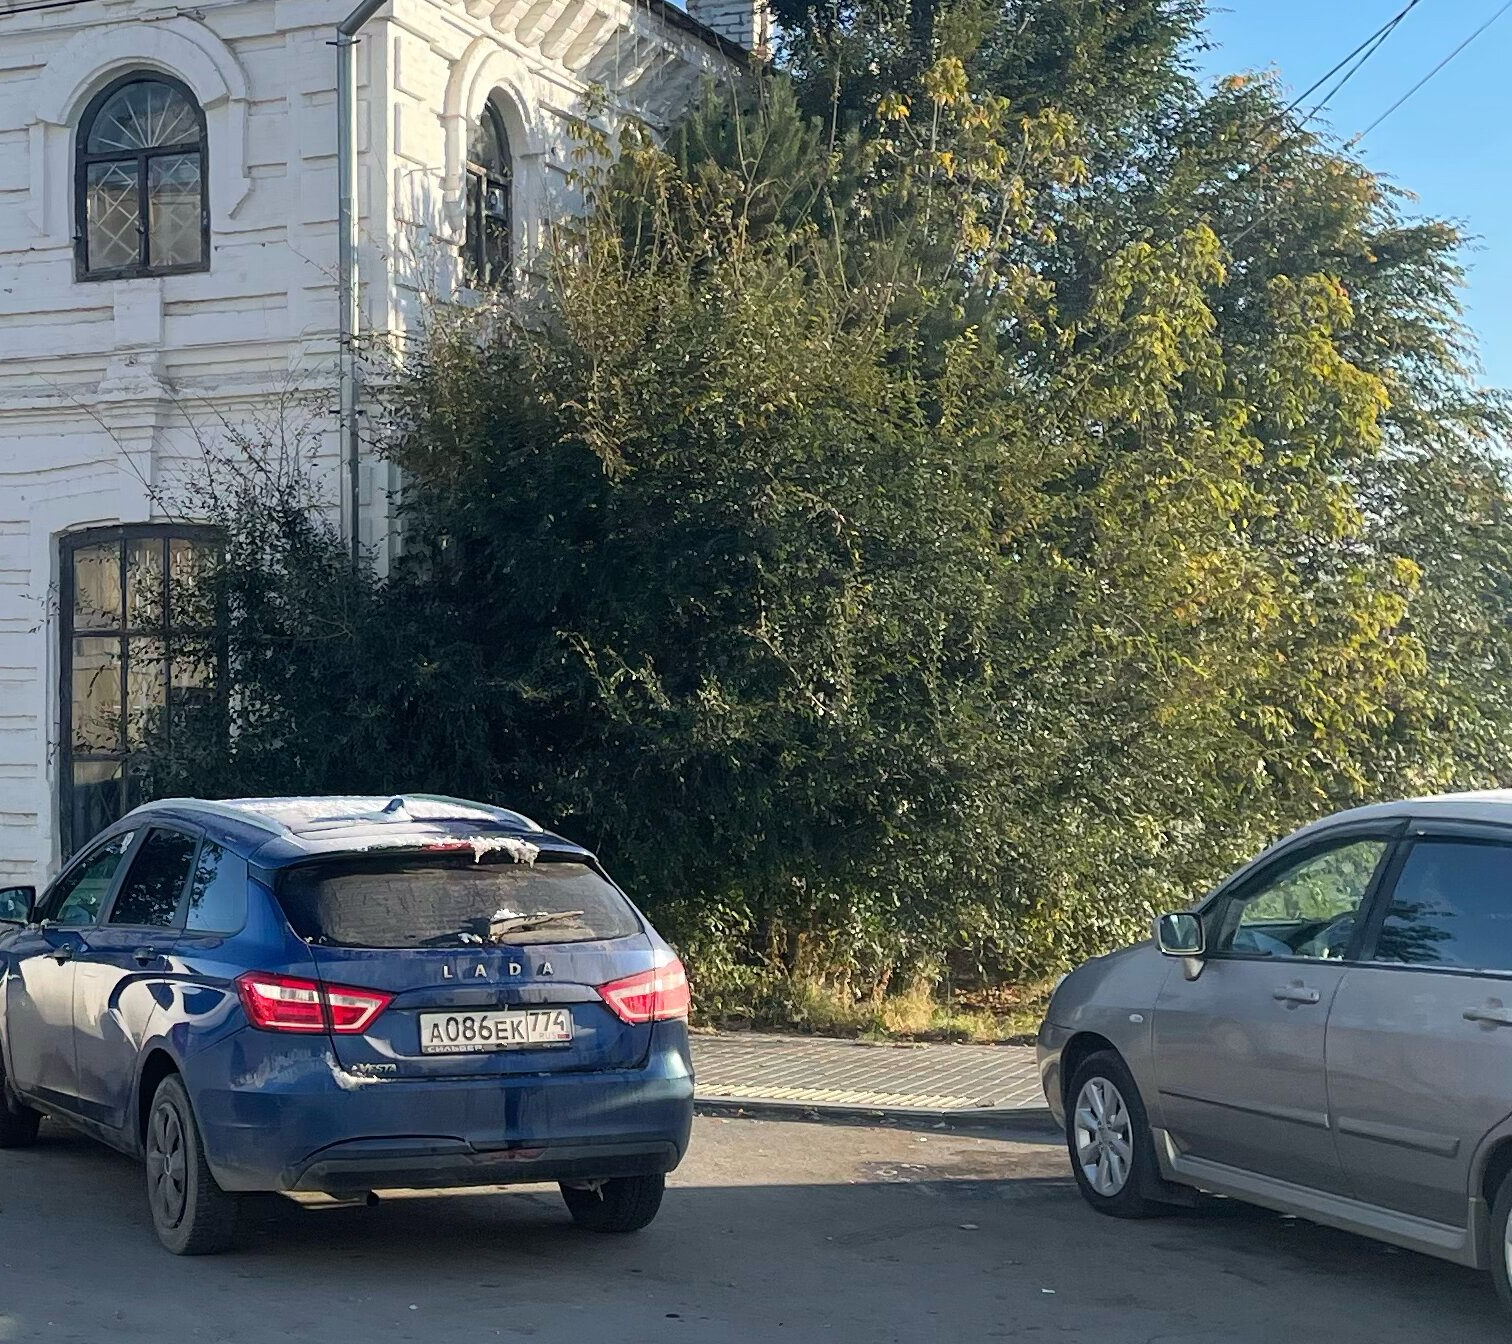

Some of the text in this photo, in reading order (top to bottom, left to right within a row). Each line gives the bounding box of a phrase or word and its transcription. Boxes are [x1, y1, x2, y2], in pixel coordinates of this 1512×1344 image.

[442, 961, 554, 979] LADA
[528, 1010, 566, 1033] 774
[539, 1031, 558, 1040] RUS
[359, 1063, 397, 1073] VESTA
